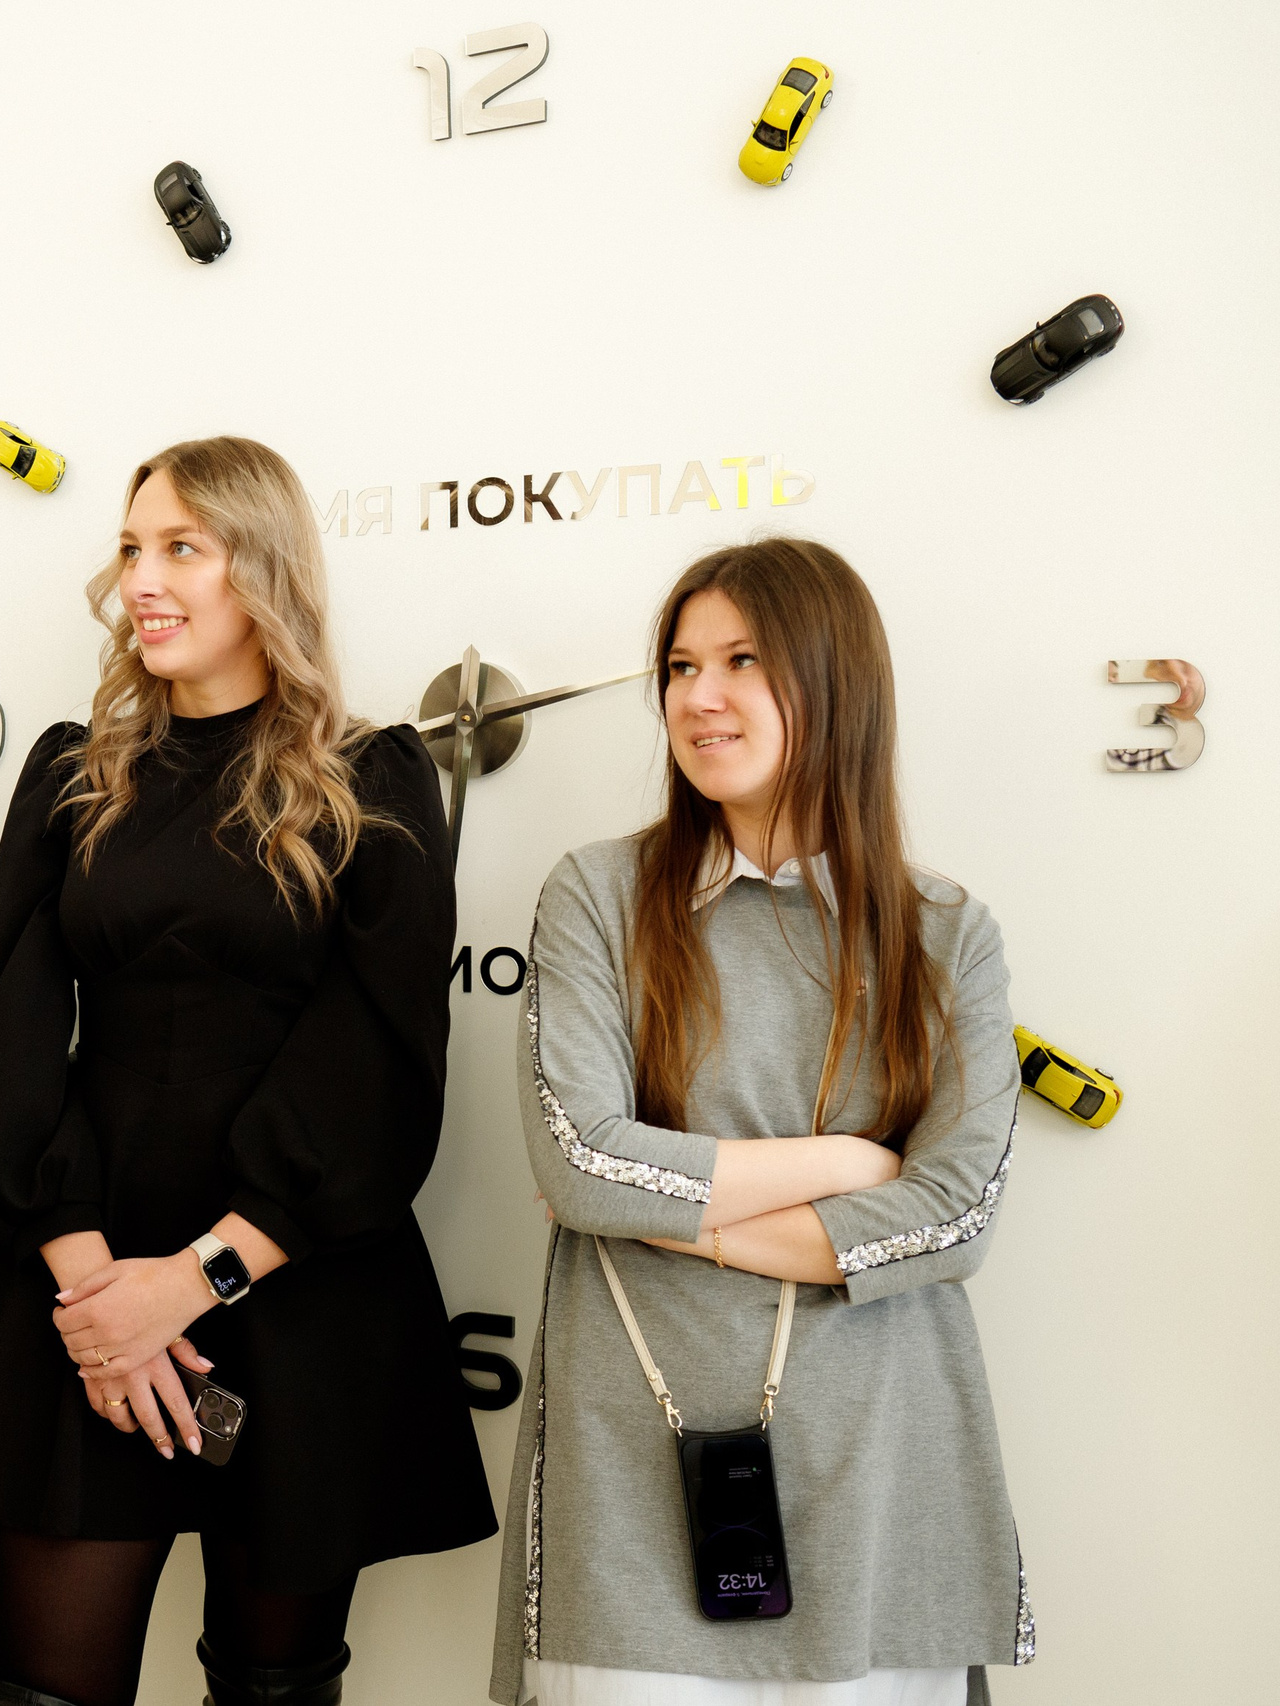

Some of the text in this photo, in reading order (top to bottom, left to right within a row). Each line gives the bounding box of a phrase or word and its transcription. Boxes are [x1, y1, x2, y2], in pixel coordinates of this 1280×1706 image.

[413, 22, 549, 141] 12
[420, 453, 816, 532] ПОКУПАТЬ
[1106, 659, 1206, 773] 3
[448, 1312, 523, 1411] 6
[718, 1573, 767, 1591] 14:32
